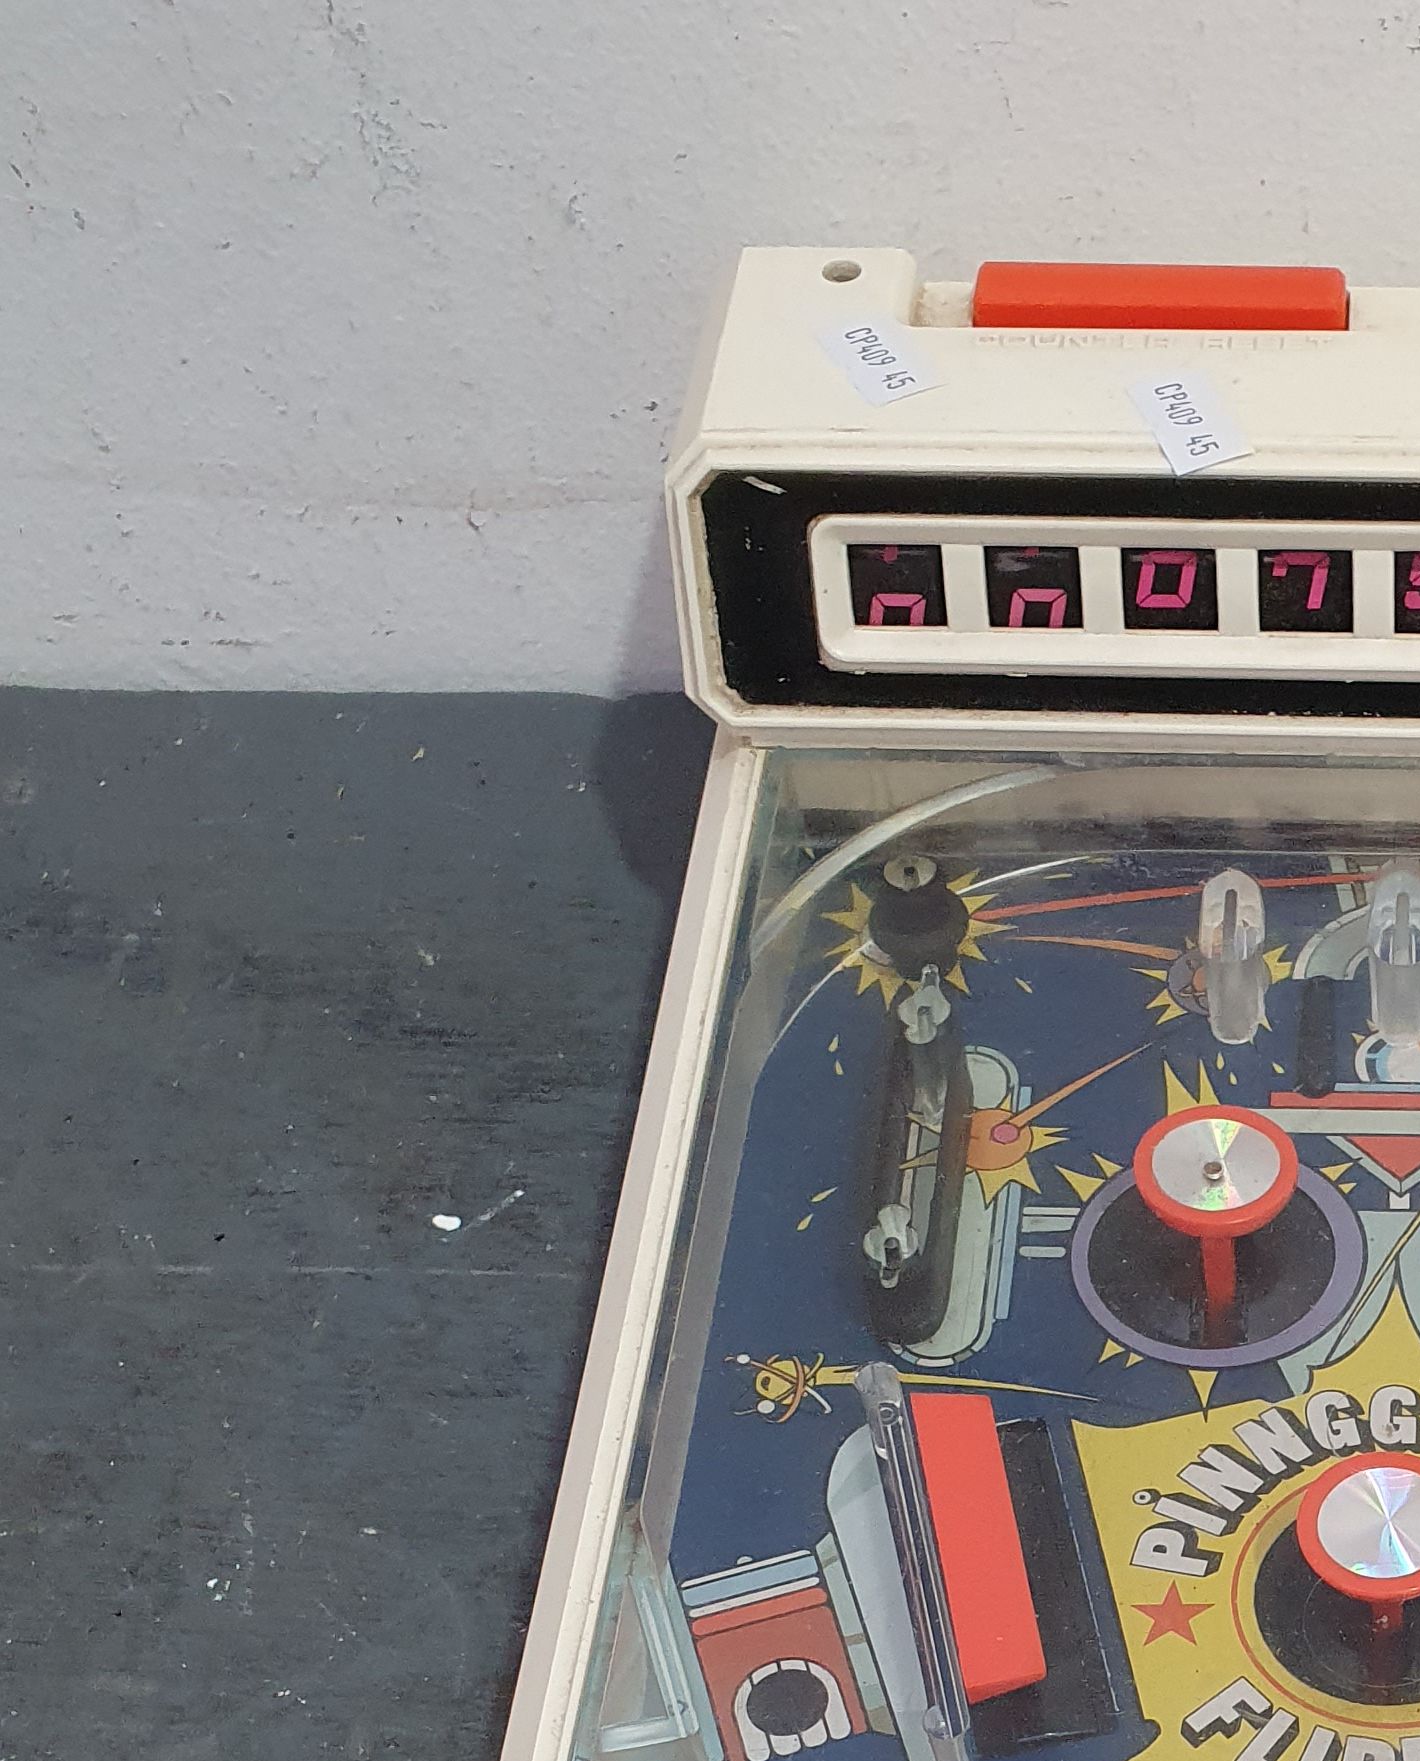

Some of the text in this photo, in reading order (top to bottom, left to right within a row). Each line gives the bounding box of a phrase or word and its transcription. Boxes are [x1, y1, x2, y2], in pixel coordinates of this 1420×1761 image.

[844, 327, 916, 390] CP409 45
[1154, 383, 1220, 456] CP409 45
